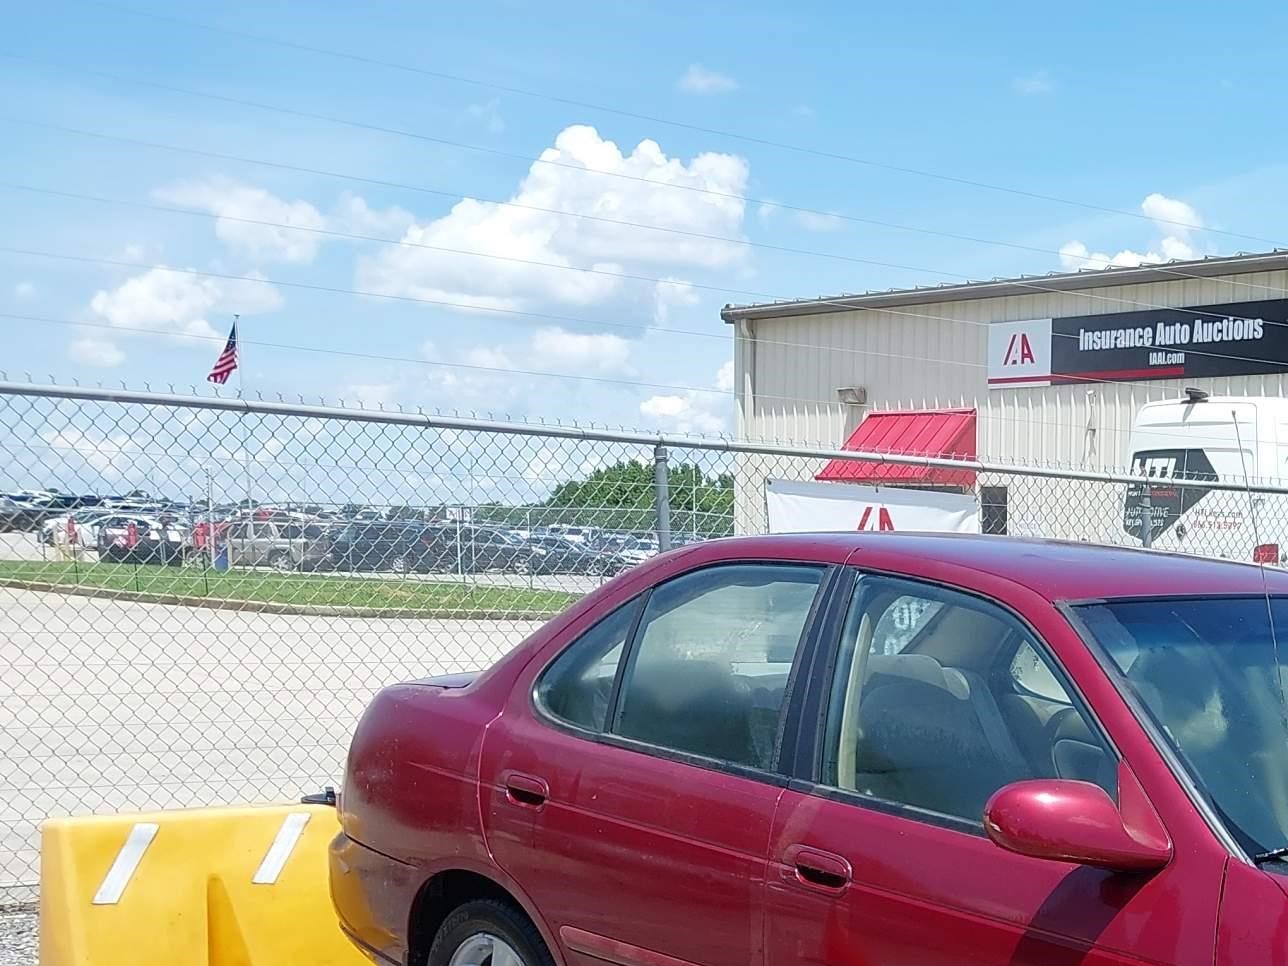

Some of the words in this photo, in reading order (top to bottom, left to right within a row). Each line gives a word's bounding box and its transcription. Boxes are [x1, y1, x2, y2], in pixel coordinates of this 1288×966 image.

[1079, 327, 1153, 352] Insurance
[1155, 322, 1190, 347] Auto
[1192, 317, 1264, 344] Auctions
[1149, 352, 1185, 366] IAAI.com
